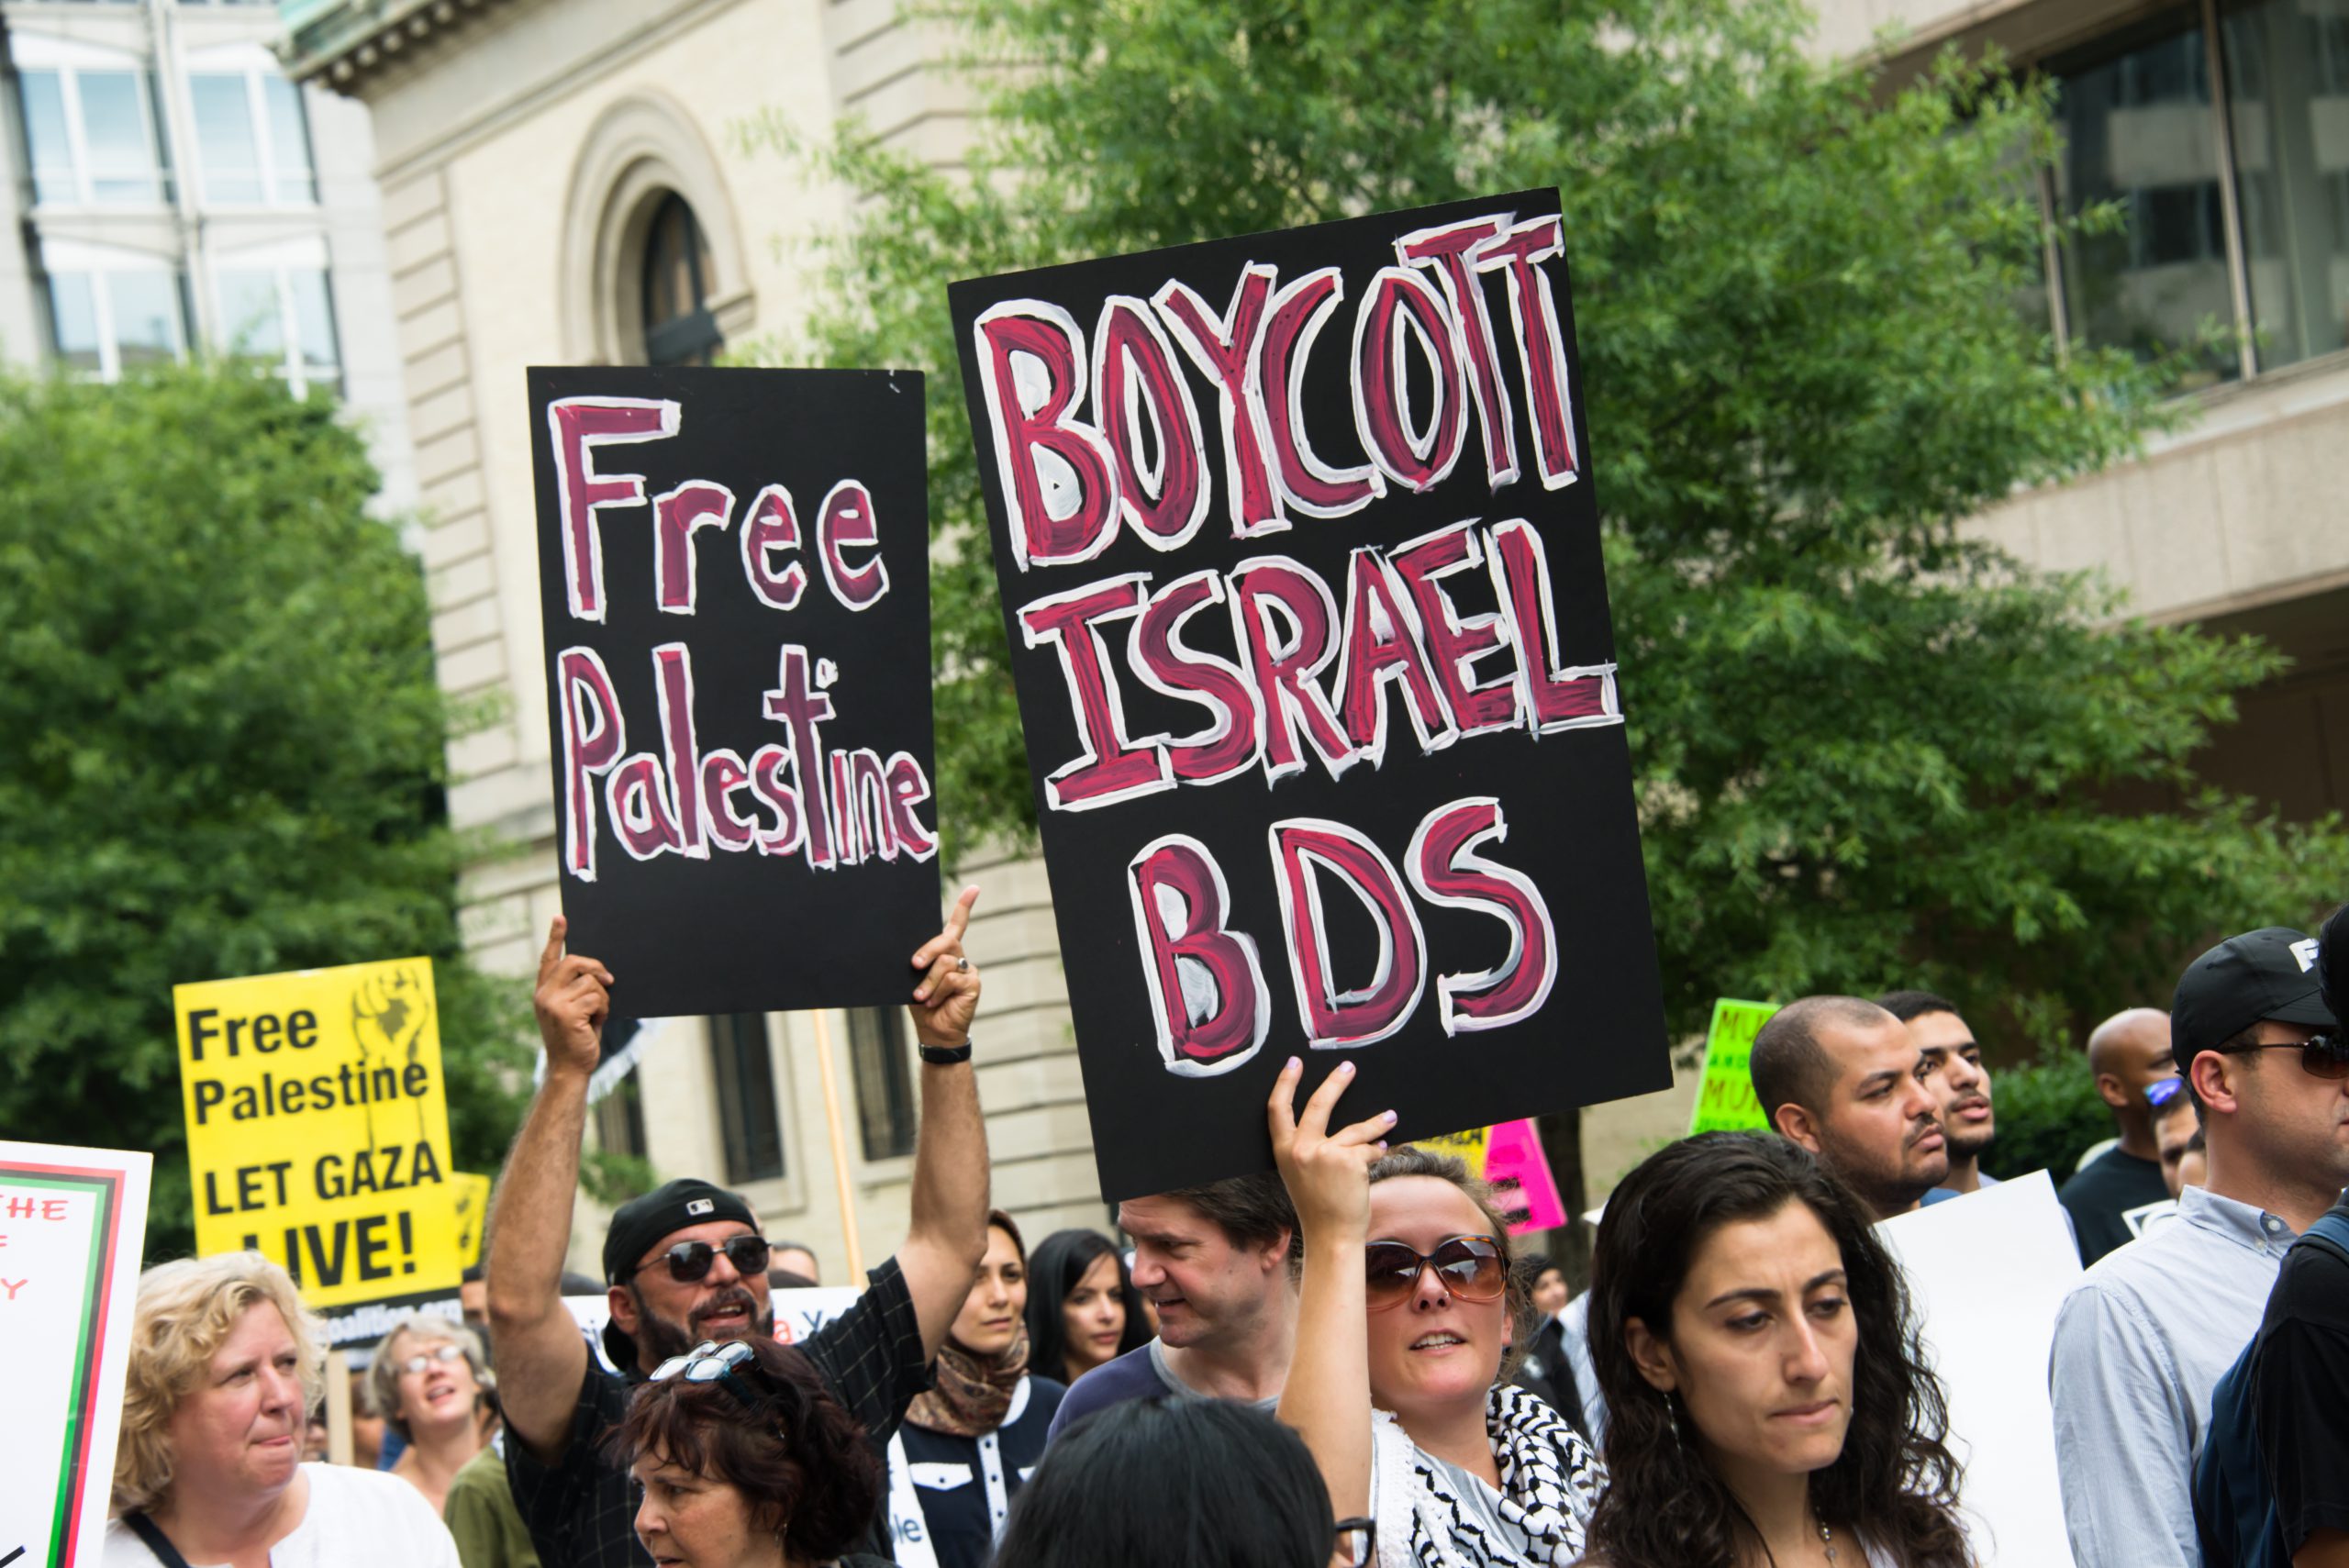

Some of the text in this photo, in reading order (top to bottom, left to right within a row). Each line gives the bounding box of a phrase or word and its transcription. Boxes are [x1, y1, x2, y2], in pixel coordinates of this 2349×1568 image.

[974, 211, 1579, 573] BOYCOTT
[549, 396, 890, 624] Free
[1019, 518, 1624, 811] ISRAEL
[558, 642, 939, 882] Palestine
[1128, 795, 1557, 1077] BDS
[188, 1008, 317, 1062] Free
[194, 1061, 429, 1125] Palestine
[0, 1194, 69, 1221] HE
[205, 1140, 442, 1216] LET GAZA
[242, 1211, 417, 1290] IVE!
